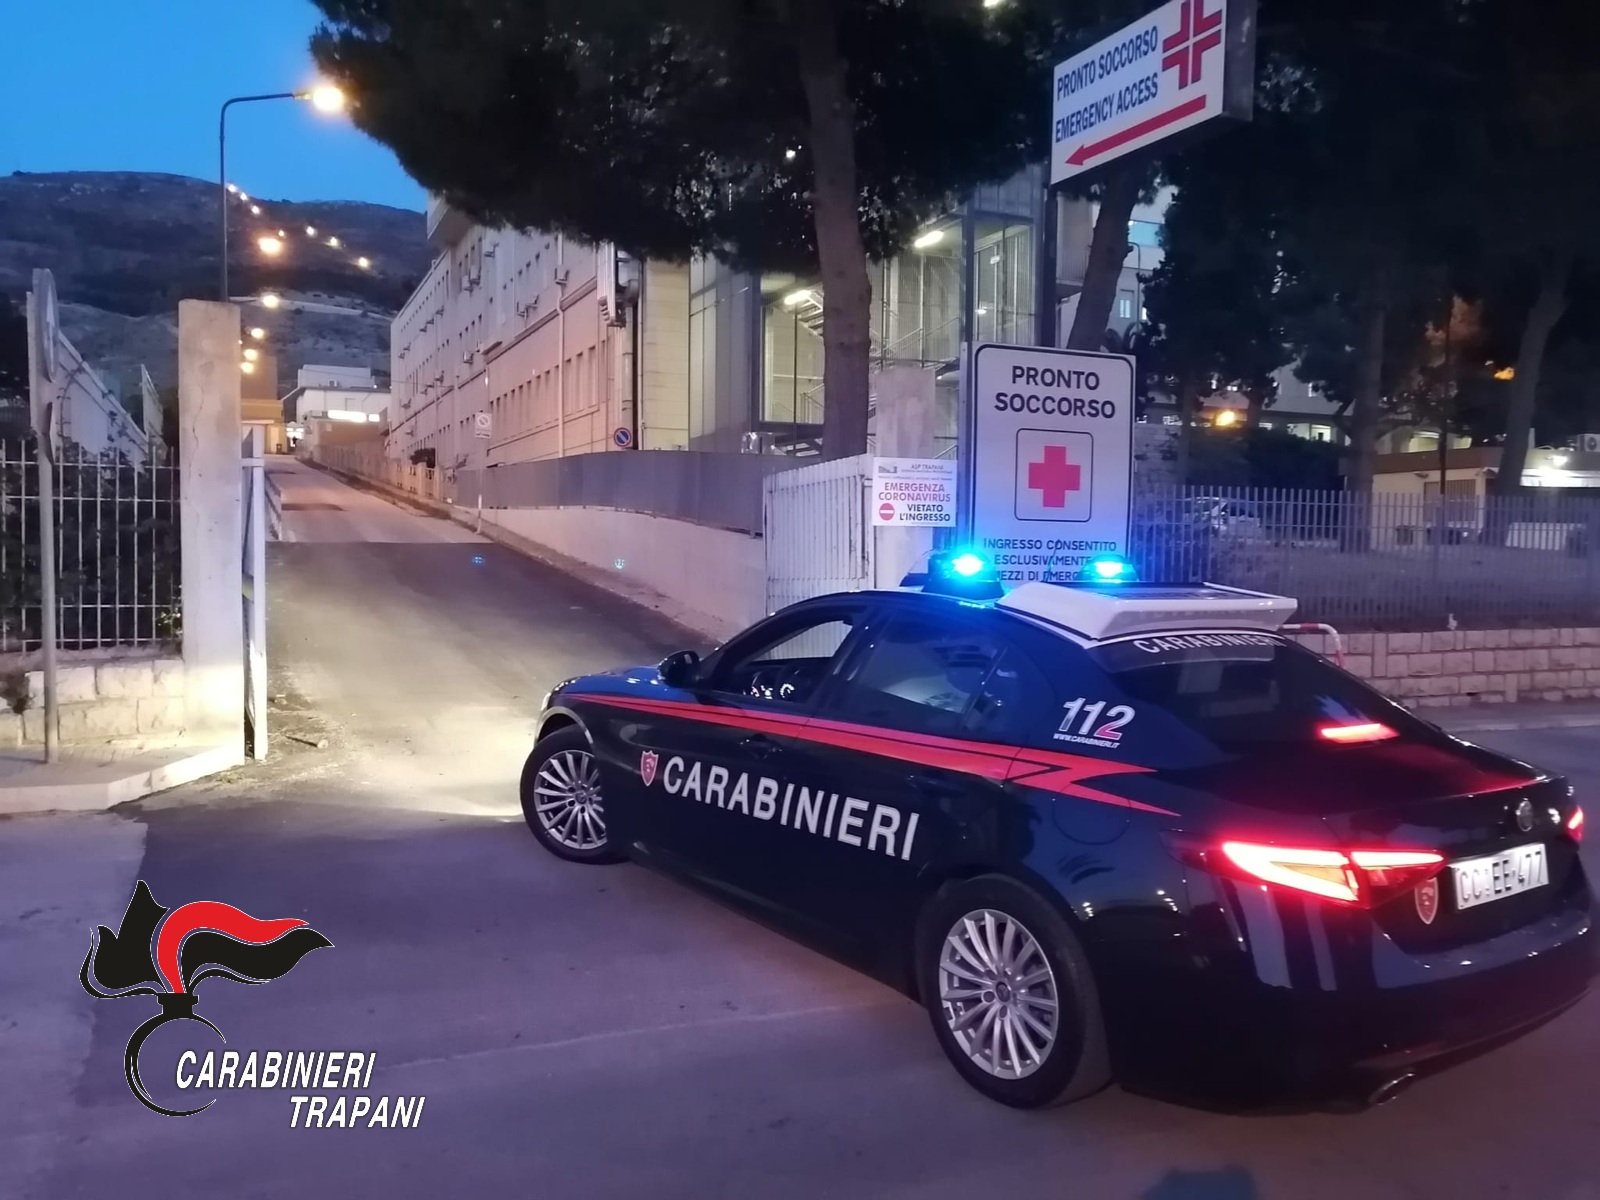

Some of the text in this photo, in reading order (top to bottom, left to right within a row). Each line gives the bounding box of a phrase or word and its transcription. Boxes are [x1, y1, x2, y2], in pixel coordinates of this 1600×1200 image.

[1057, 26, 1158, 101] PRONTO SOCCORSO
[1055, 73, 1158, 143] EMERGENCY ACCESS
[1011, 365, 1100, 390] PRONTO
[994, 392, 1116, 418] SOCCORSO
[884, 482, 945, 492] EMERGENZA
[878, 492, 951, 502] CORONAVIRUS
[899, 513, 951, 521] L'INGRESSO
[907, 504, 944, 512] VIETATO
[983, 538, 1117, 551] INGRESSO CONSENTITO
[1028, 571, 1039, 581] DI
[1132, 635, 1287, 653] CARABINIERI
[1058, 697, 1136, 741] 112
[663, 756, 920, 861] CARABINIERI
